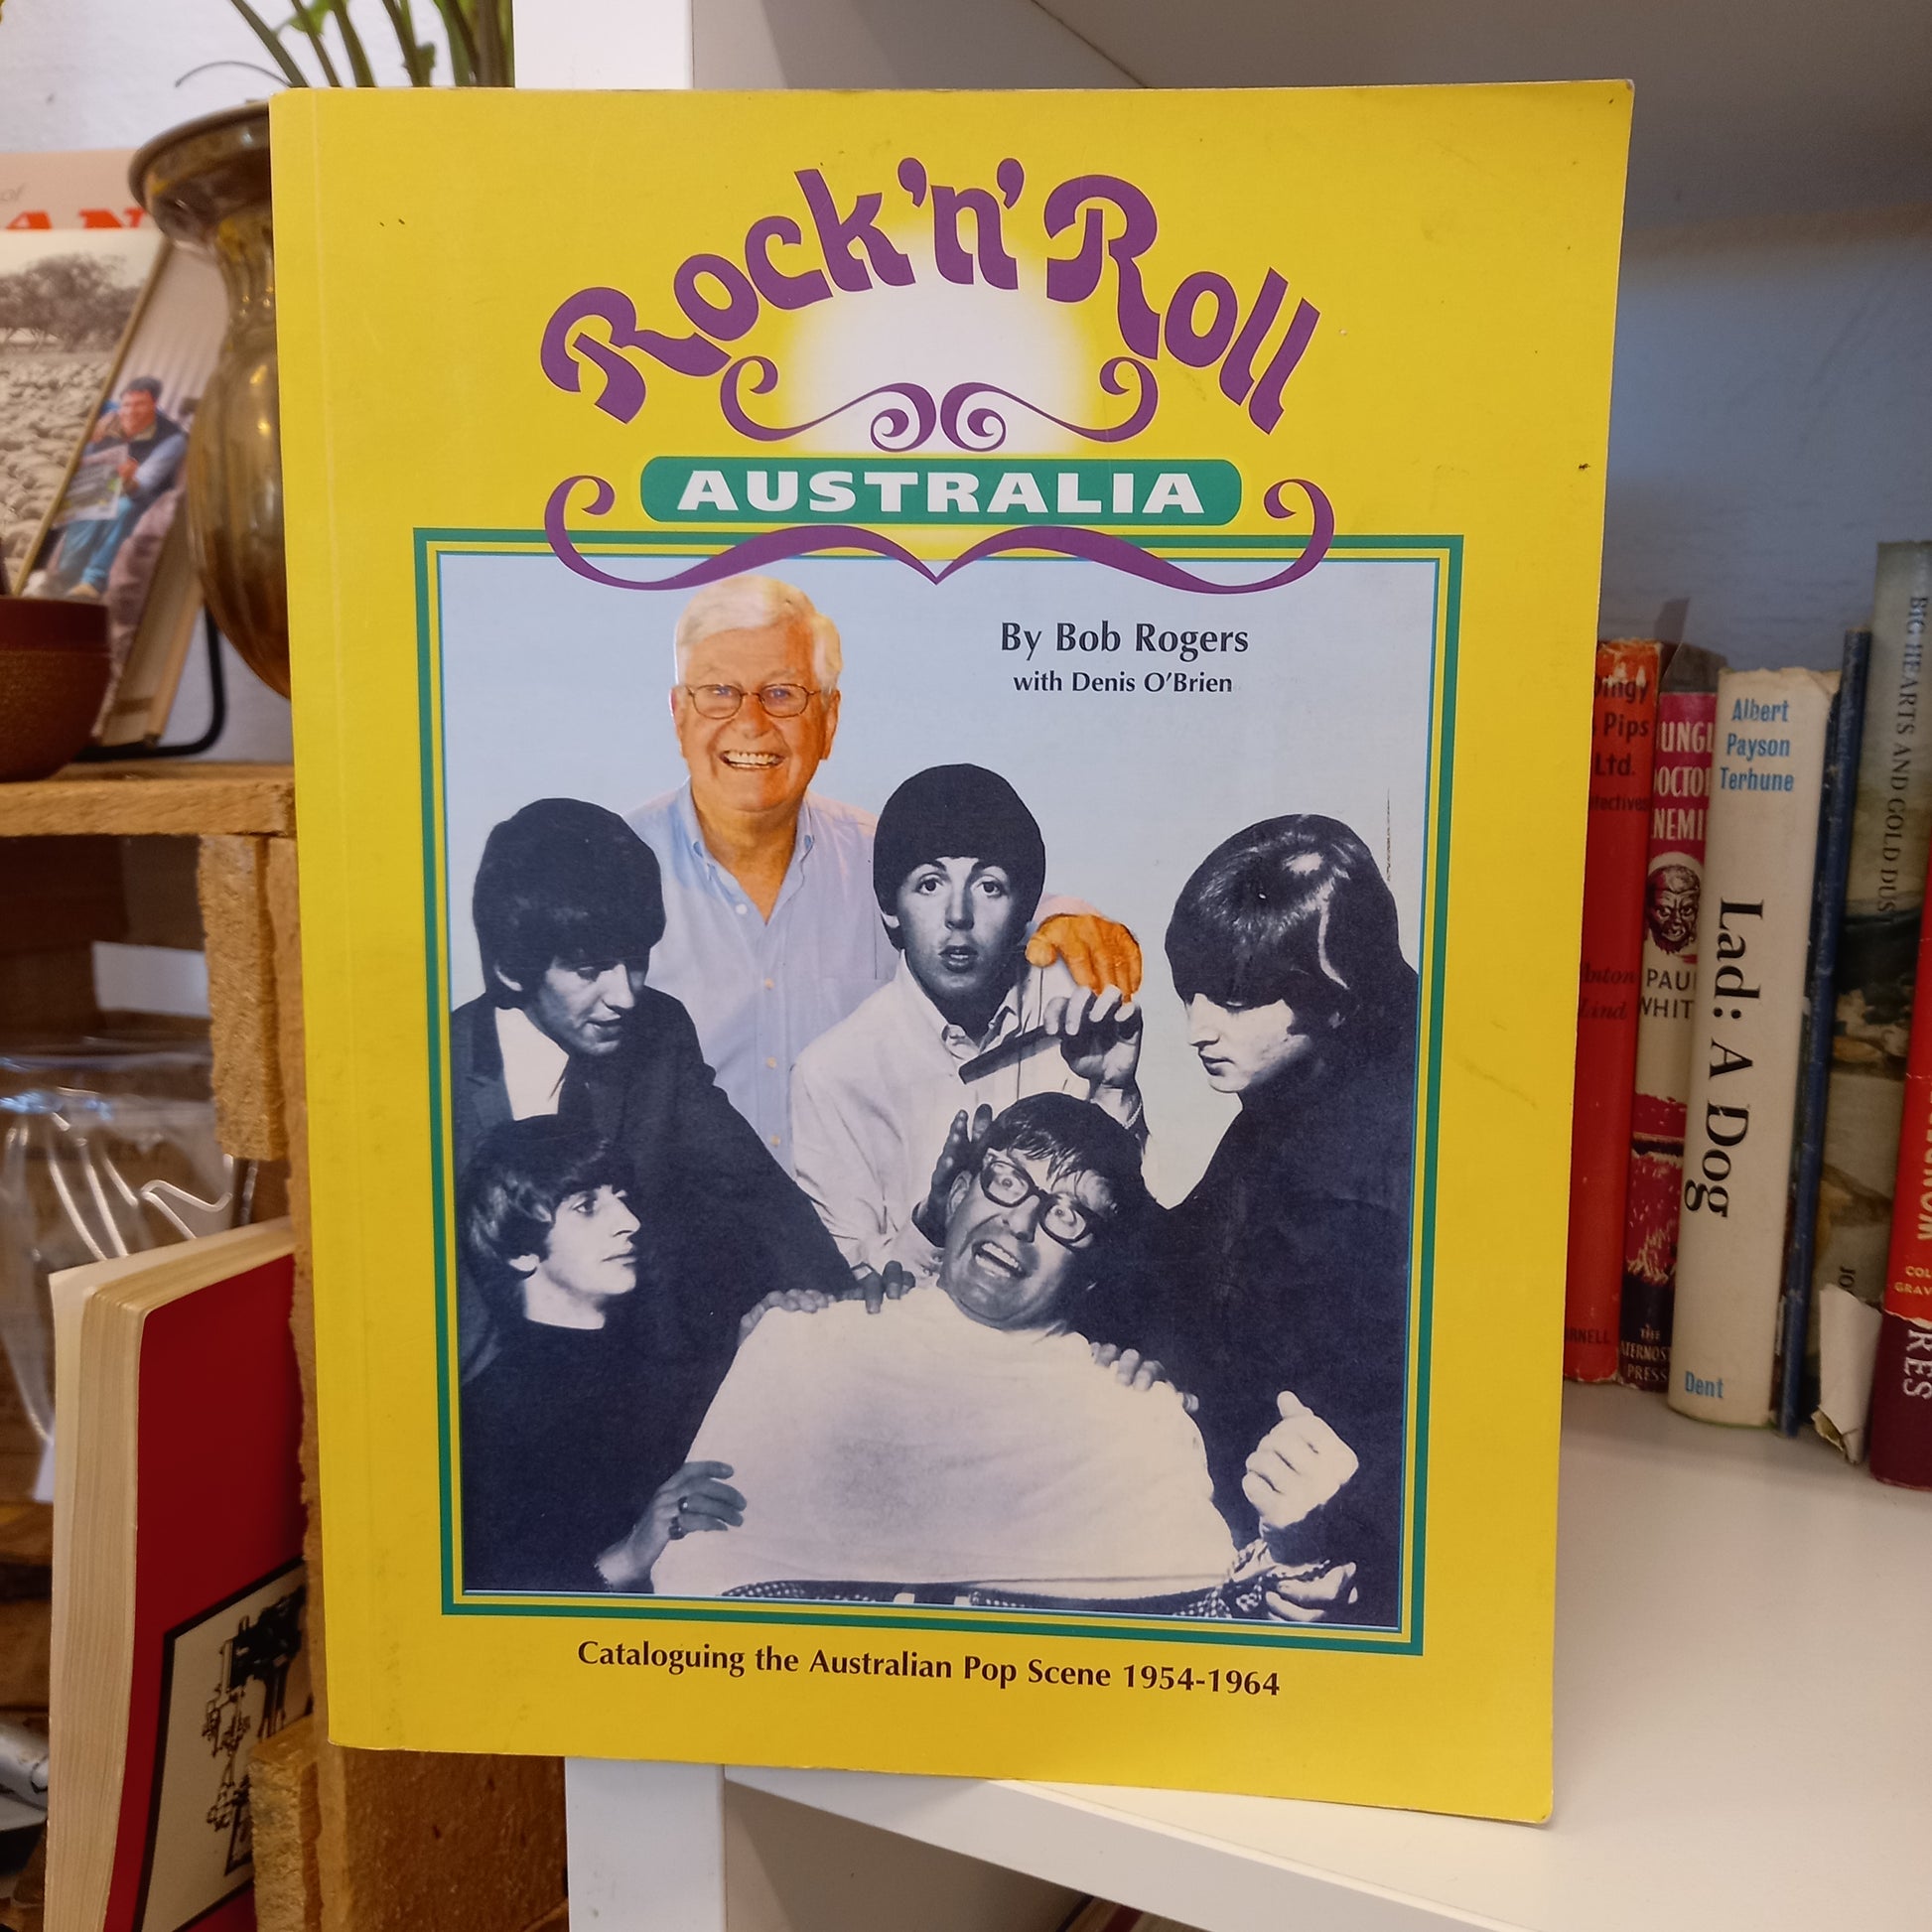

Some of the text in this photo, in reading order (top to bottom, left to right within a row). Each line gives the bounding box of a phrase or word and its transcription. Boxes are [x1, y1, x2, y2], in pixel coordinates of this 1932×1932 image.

[677, 470, 1205, 514] AUSTRALIA
[1906, 597, 1929, 634] BIG
[1001, 620, 1249, 663] By Bob Rogers
[1013, 669, 1233, 693] with Denis O'Brien
[1896, 642, 1923, 735] HEARTS
[1731, 698, 1789, 722] Albert
[1603, 712, 1648, 743] Pips
[1726, 733, 1790, 761] Payson
[1595, 753, 1635, 775] Ltd.
[1720, 766, 1794, 791] Terhune
[1890, 742, 1912, 790] AND
[1654, 766, 1710, 797] OCTO
[1882, 798, 1906, 861] GOLD
[1647, 968, 1697, 991] PAU
[1684, 897, 1764, 1218] Lad: A Dog
[1628, 1364, 1668, 1382] PRESS
[1685, 1370, 1724, 1398] Dent
[578, 1640, 1281, 1697] Cataloguing the Australian Pop Scene 1954-1964
